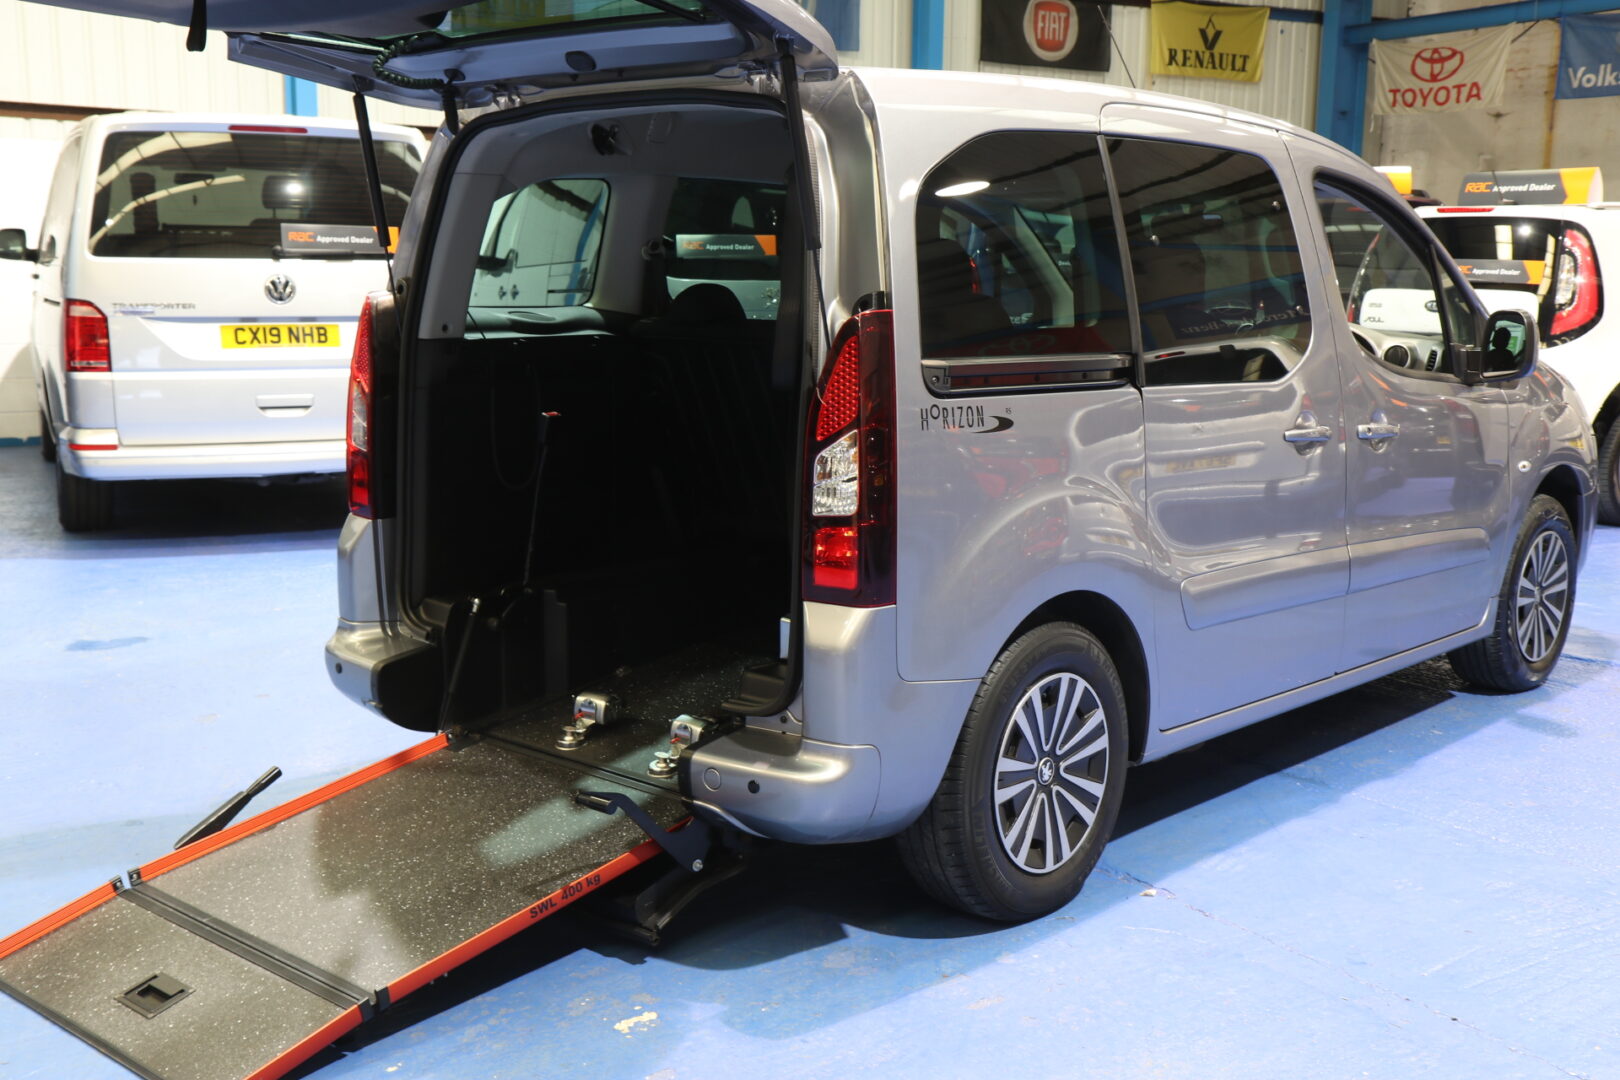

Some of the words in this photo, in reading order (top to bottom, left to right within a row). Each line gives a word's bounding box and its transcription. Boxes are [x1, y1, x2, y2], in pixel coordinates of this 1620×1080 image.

[1036, 9, 1068, 42] FIAT
[1166, 47, 1250, 73] RENAULT
[1567, 64, 1620, 89] Volk
[1388, 81, 1483, 108] TOYOTA
[1493, 183, 1528, 194] Approved
[1529, 182, 1557, 193] Dealer
[316, 235, 349, 244] Approved
[350, 235, 374, 244] Dealer
[706, 243, 734, 251] Approved
[234, 326, 282, 345] CX19
[287, 326, 328, 344] NHB
[920, 403, 985, 431] HORIZON
[529, 897, 557, 919] SWL
[561, 881, 583, 901] 400
[586, 873, 601, 887] kg
